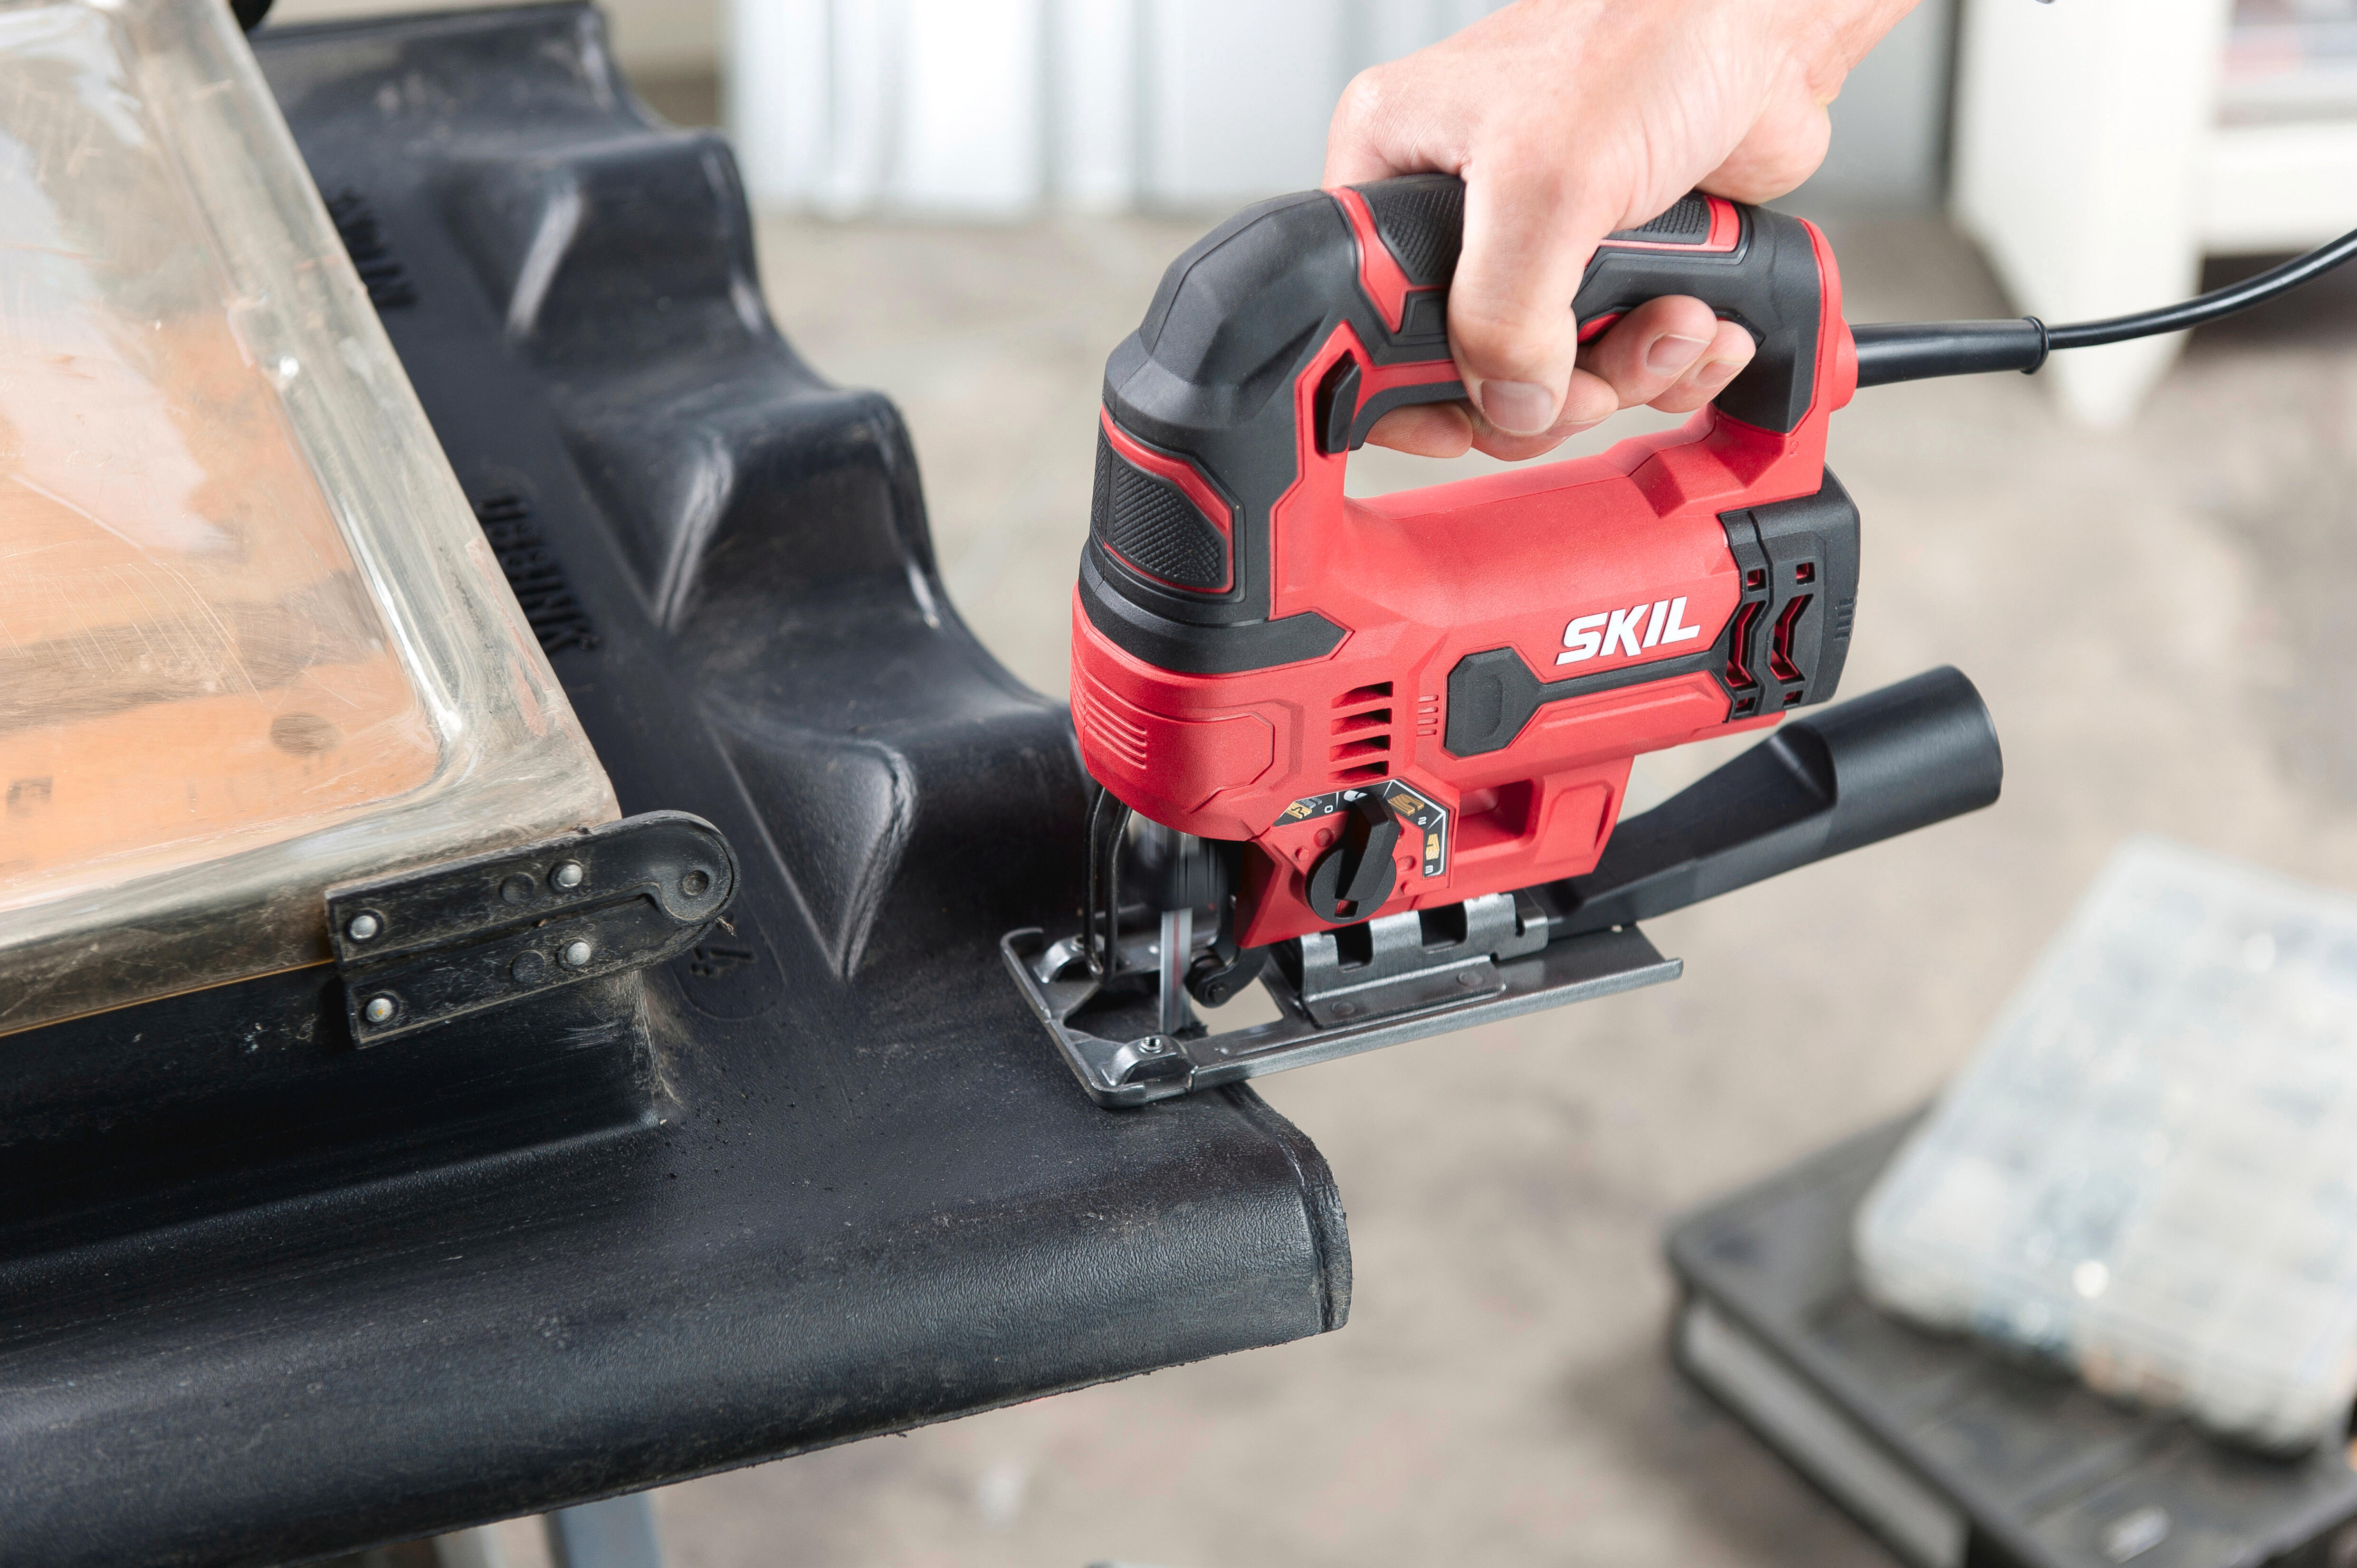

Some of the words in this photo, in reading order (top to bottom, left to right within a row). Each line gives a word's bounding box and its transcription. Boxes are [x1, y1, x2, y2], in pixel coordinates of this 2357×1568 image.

[1555, 596, 1701, 665] SKIL
[1418, 816, 1427, 826] 2
[1425, 865, 1434, 874] 3
